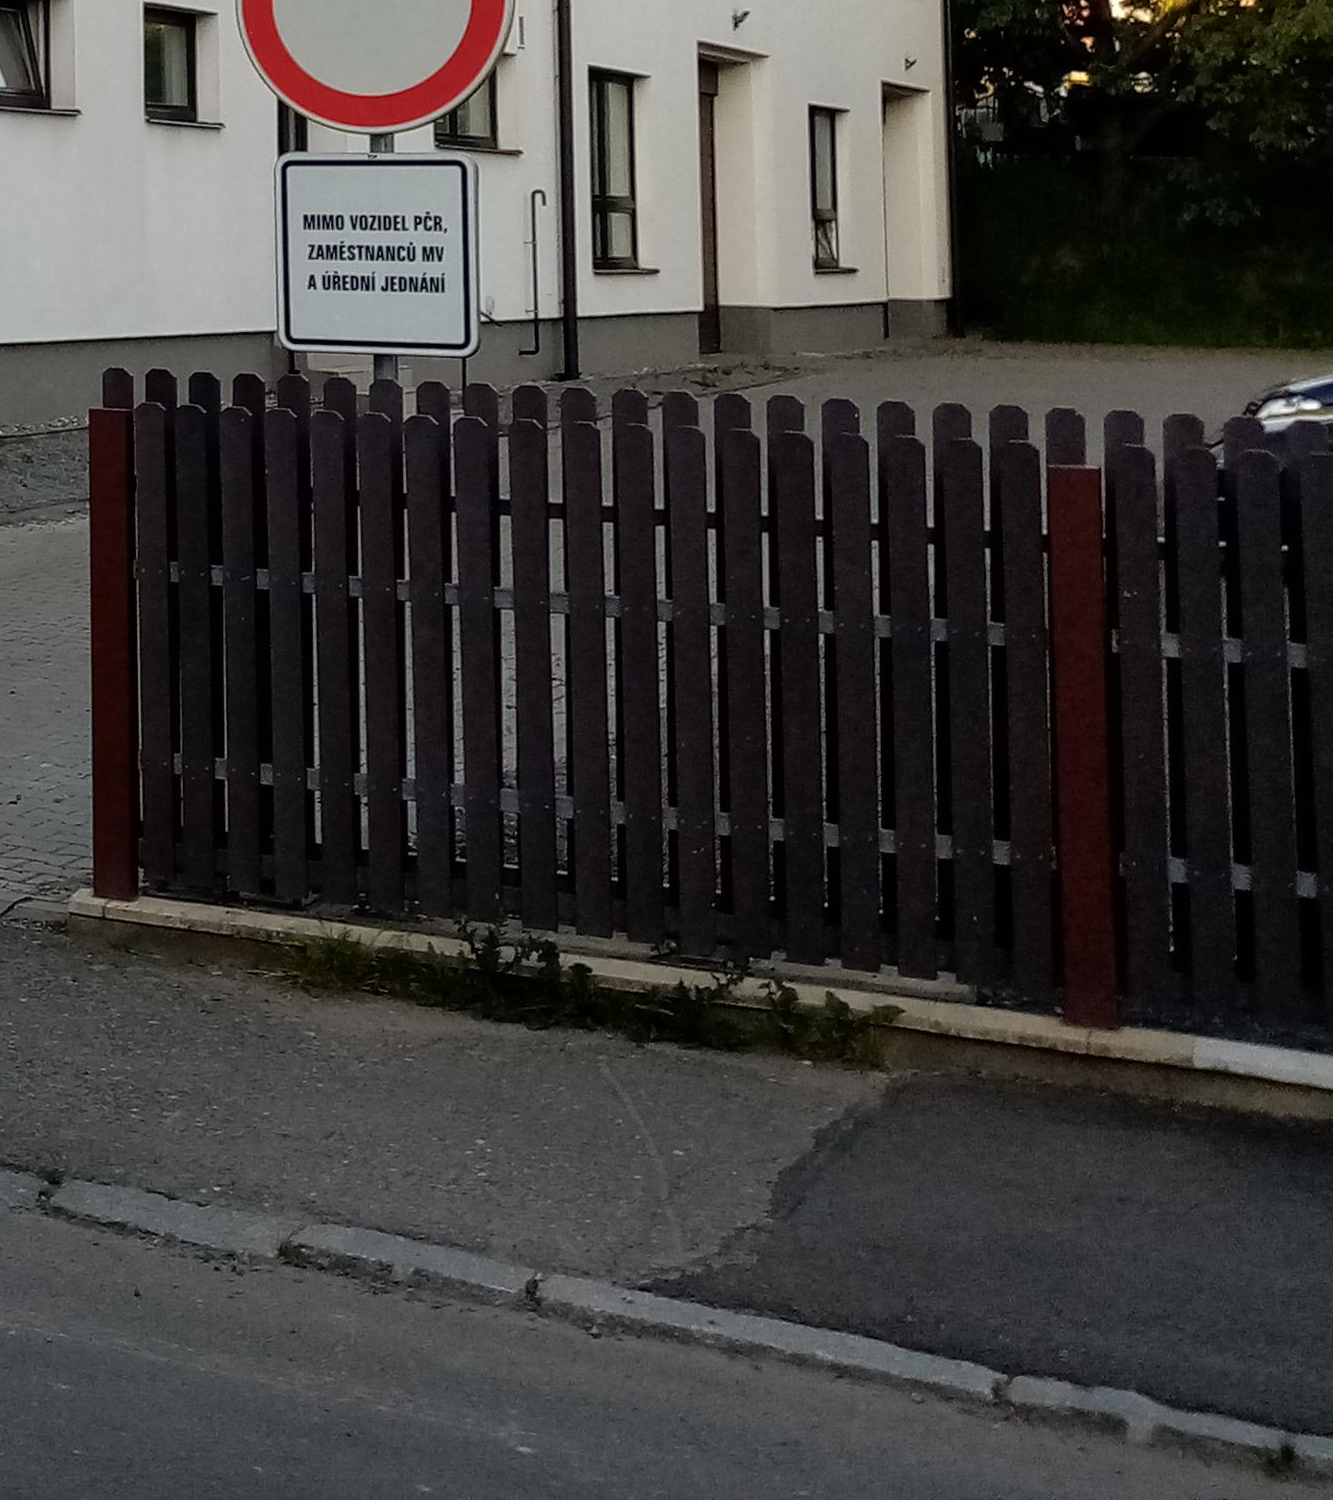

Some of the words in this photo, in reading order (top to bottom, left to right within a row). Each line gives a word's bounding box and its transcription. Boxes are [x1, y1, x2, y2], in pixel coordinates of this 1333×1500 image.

[303, 214, 345, 231] MIMO
[349, 214, 409, 232] VOZIDEL
[413, 211, 448, 234] PČR,
[307, 241, 416, 262] ZAMĚSTNANCŮ
[421, 245, 444, 263] MV
[307, 274, 317, 290] A
[322, 271, 376, 292] ÚŘEDNÍ
[380, 272, 445, 293] JEDNÁNÍ
